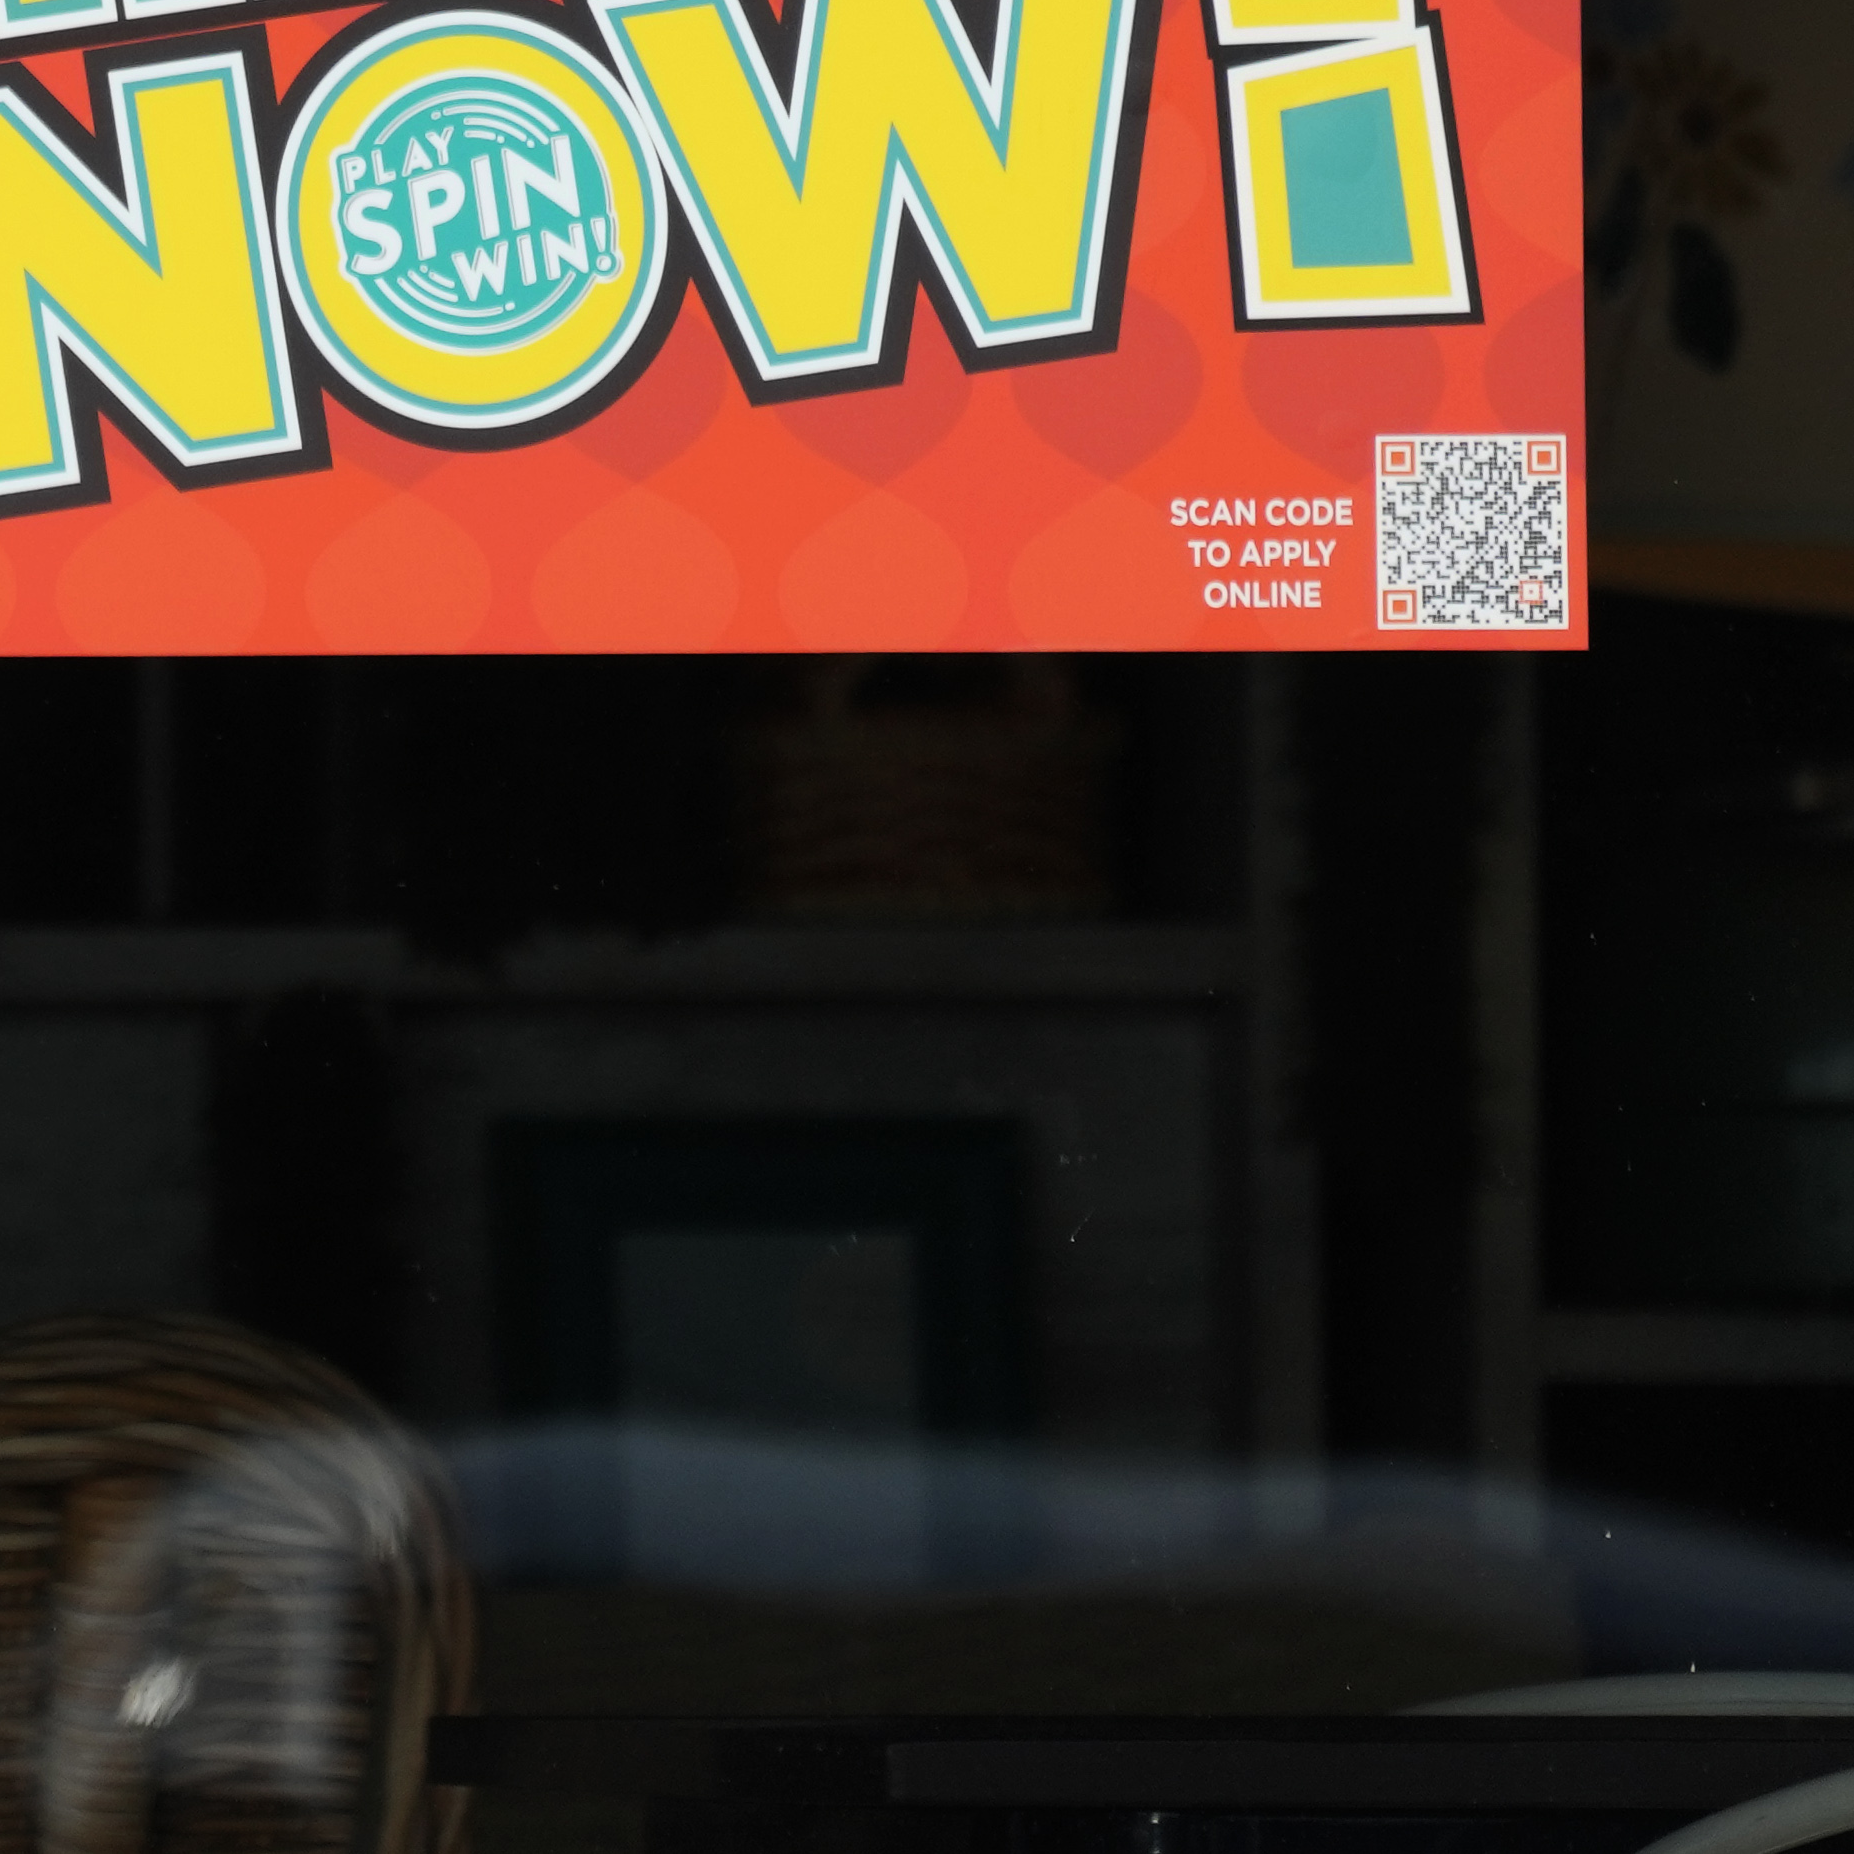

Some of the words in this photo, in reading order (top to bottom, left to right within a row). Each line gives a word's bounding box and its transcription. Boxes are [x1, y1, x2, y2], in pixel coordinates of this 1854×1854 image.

[341, 126, 454, 192] PLAY
[344, 134, 580, 274] SPIN
[452, 217, 611, 301] WIN!
[1171, 499, 1255, 526] SCAN
[1266, 498, 1353, 526] CODE
[1188, 540, 1230, 567] TO
[1240, 540, 1336, 566] APPLY
[1204, 581, 1321, 608] ONLINE
